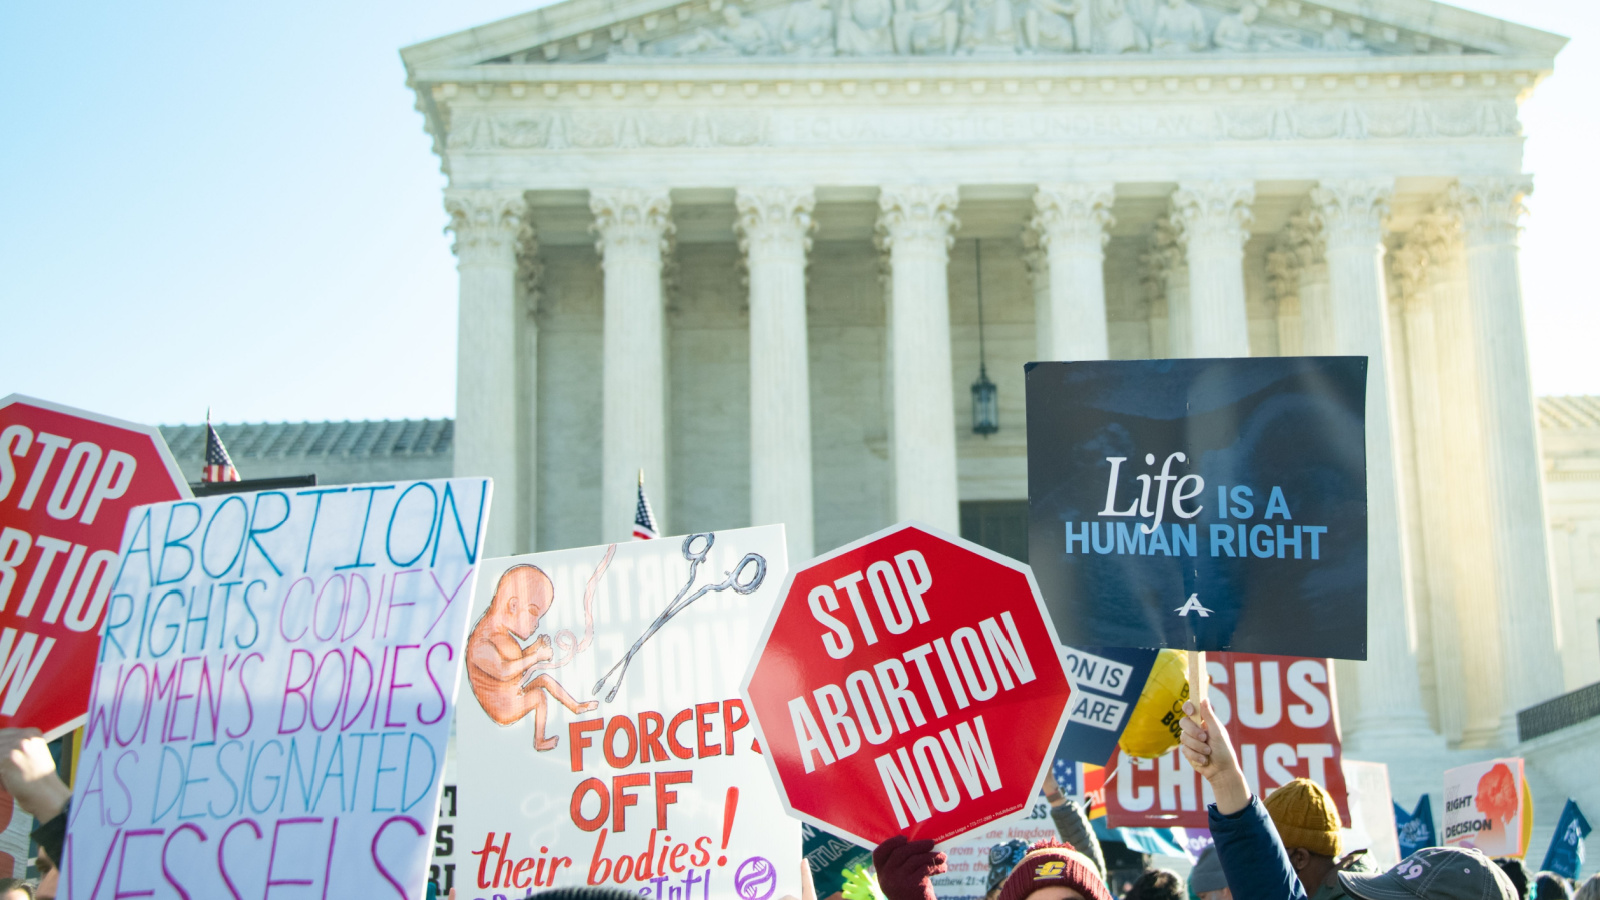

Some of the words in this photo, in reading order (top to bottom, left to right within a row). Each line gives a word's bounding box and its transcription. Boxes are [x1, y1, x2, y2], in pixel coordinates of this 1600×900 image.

[793, 115, 888, 139] EQUAL
[899, 115, 1016, 139] JUSTICE
[1029, 115, 1121, 138] UNDER
[1139, 115, 1191, 138] LAW
[0, 424, 137, 526] STOP
[1097, 451, 1205, 535] Life
[1217, 485, 1254, 519] IS
[1263, 486, 1292, 520] A
[113, 480, 488, 590] ABORTION
[1065, 521, 1198, 557] HUMAN
[1209, 524, 1328, 560] RIGHT
[100, 579, 267, 662] RIGHTS
[279, 568, 475, 643] CODIFY
[807, 549, 933, 660] STOP
[84, 652, 264, 750] WOMEN'S
[277, 642, 453, 735] BODIES
[787, 610, 1037, 774] ABORTION
[1100, 665, 1124, 688] IS
[568, 698, 763, 772] FORCEP
[874, 714, 1003, 830] NOW
[69, 749, 139, 827] AS
[151, 732, 437, 824] DESIGNATED
[569, 770, 693, 833] OFF
[1446, 795, 1472, 813] RIGHT
[471, 832, 572, 890] their
[586, 786, 740, 886] bodies!
[1007, 827, 1056, 841] kingdom
[1397, 860, 1423, 880] 49
[1446, 819, 1493, 839] DECISION
